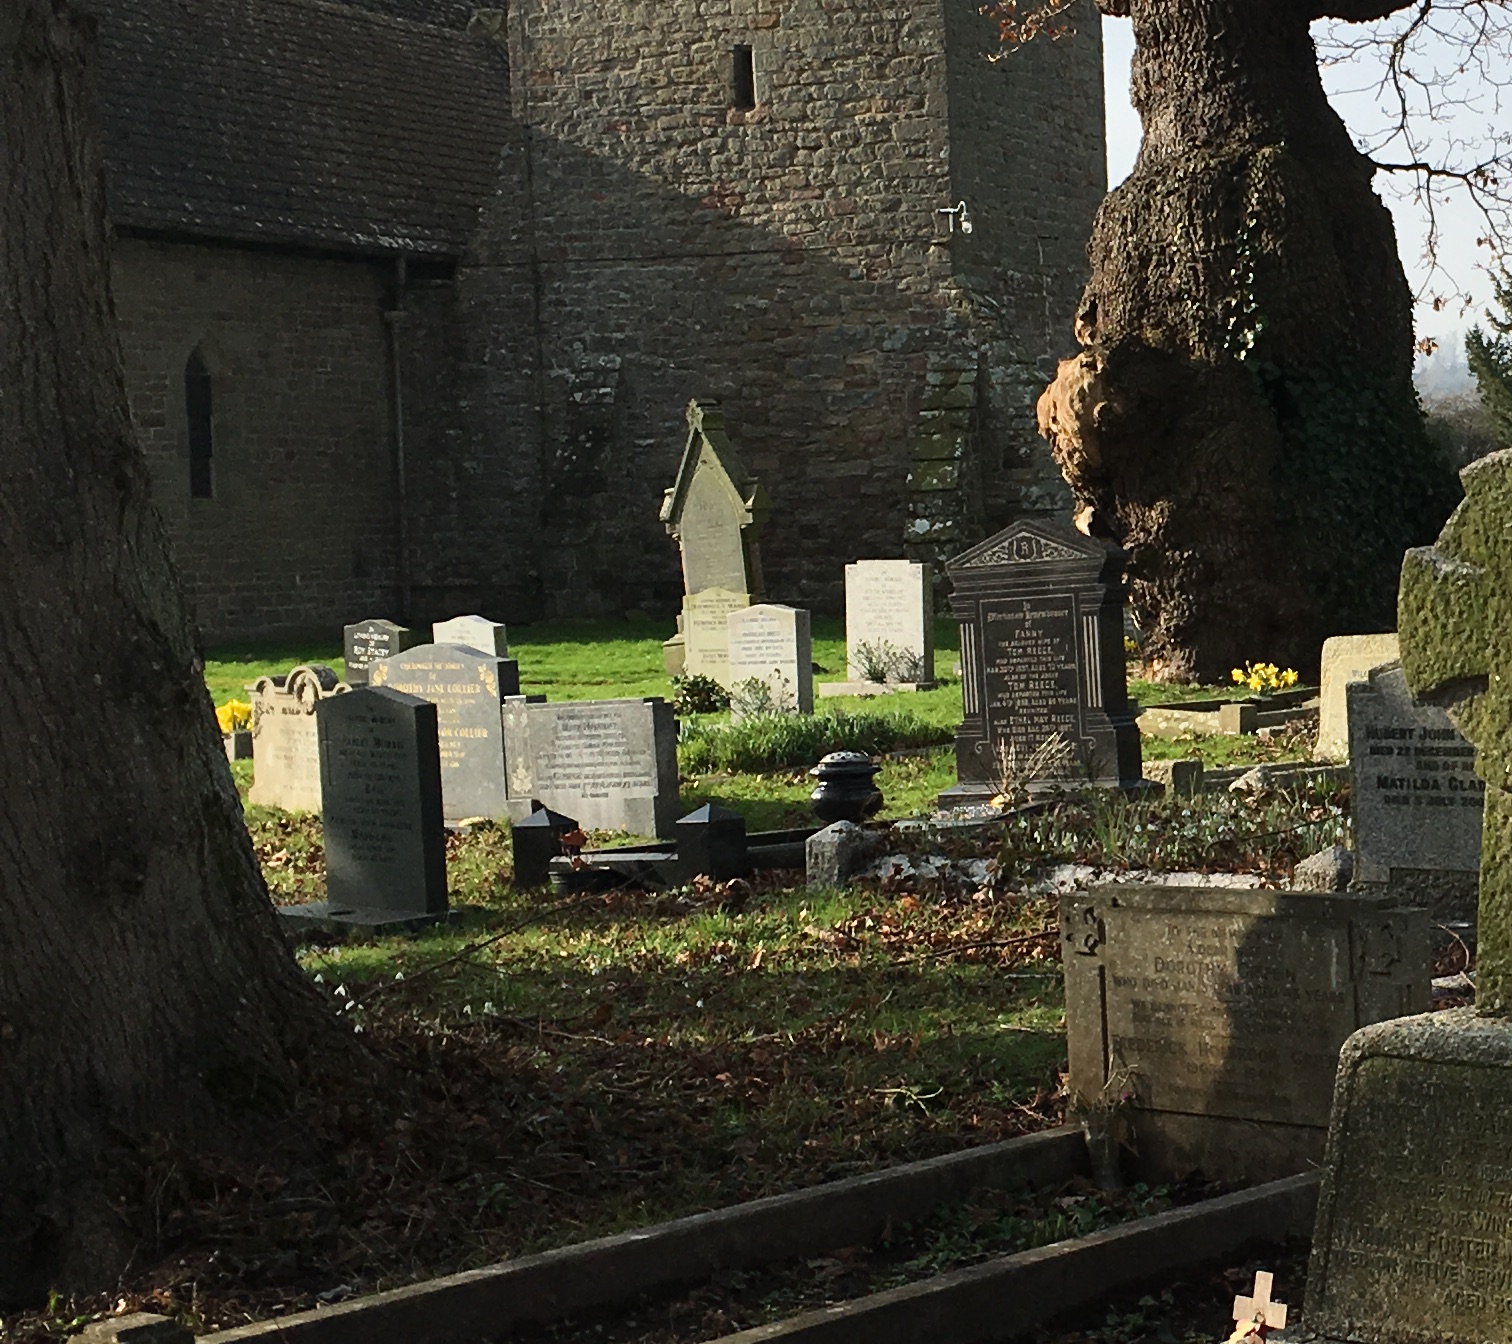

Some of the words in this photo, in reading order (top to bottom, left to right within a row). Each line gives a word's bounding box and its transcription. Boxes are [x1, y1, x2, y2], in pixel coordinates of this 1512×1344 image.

[1365, 726, 1416, 741] HUBERT
[1419, 727, 1455, 741] JOHN
[1376, 775, 1441, 791] MATILDA
[1154, 956, 1227, 976] DOROTHY
[1427, 1235, 1501, 1261] FOSTER
